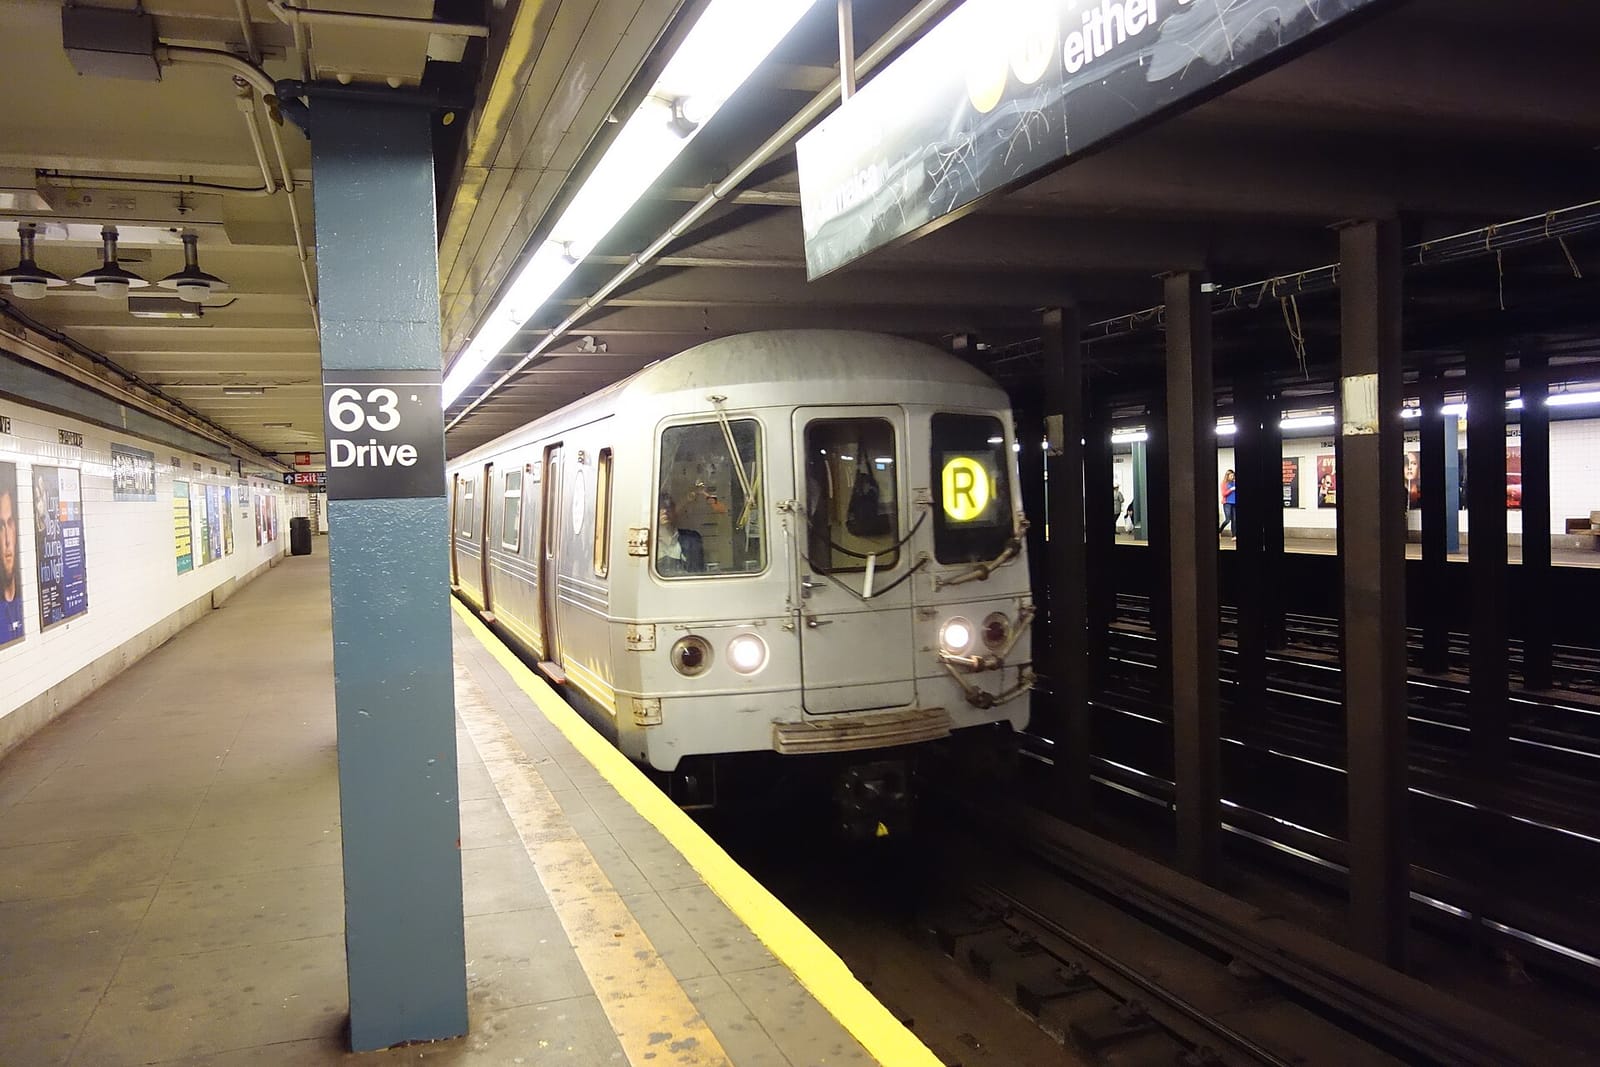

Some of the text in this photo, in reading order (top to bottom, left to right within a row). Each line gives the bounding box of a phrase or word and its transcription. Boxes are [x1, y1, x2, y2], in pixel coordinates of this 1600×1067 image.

[329, 388, 401, 432] 63
[330, 439, 418, 468] Drive
[295, 473, 317, 483] Exit
[953, 467, 976, 509] R
